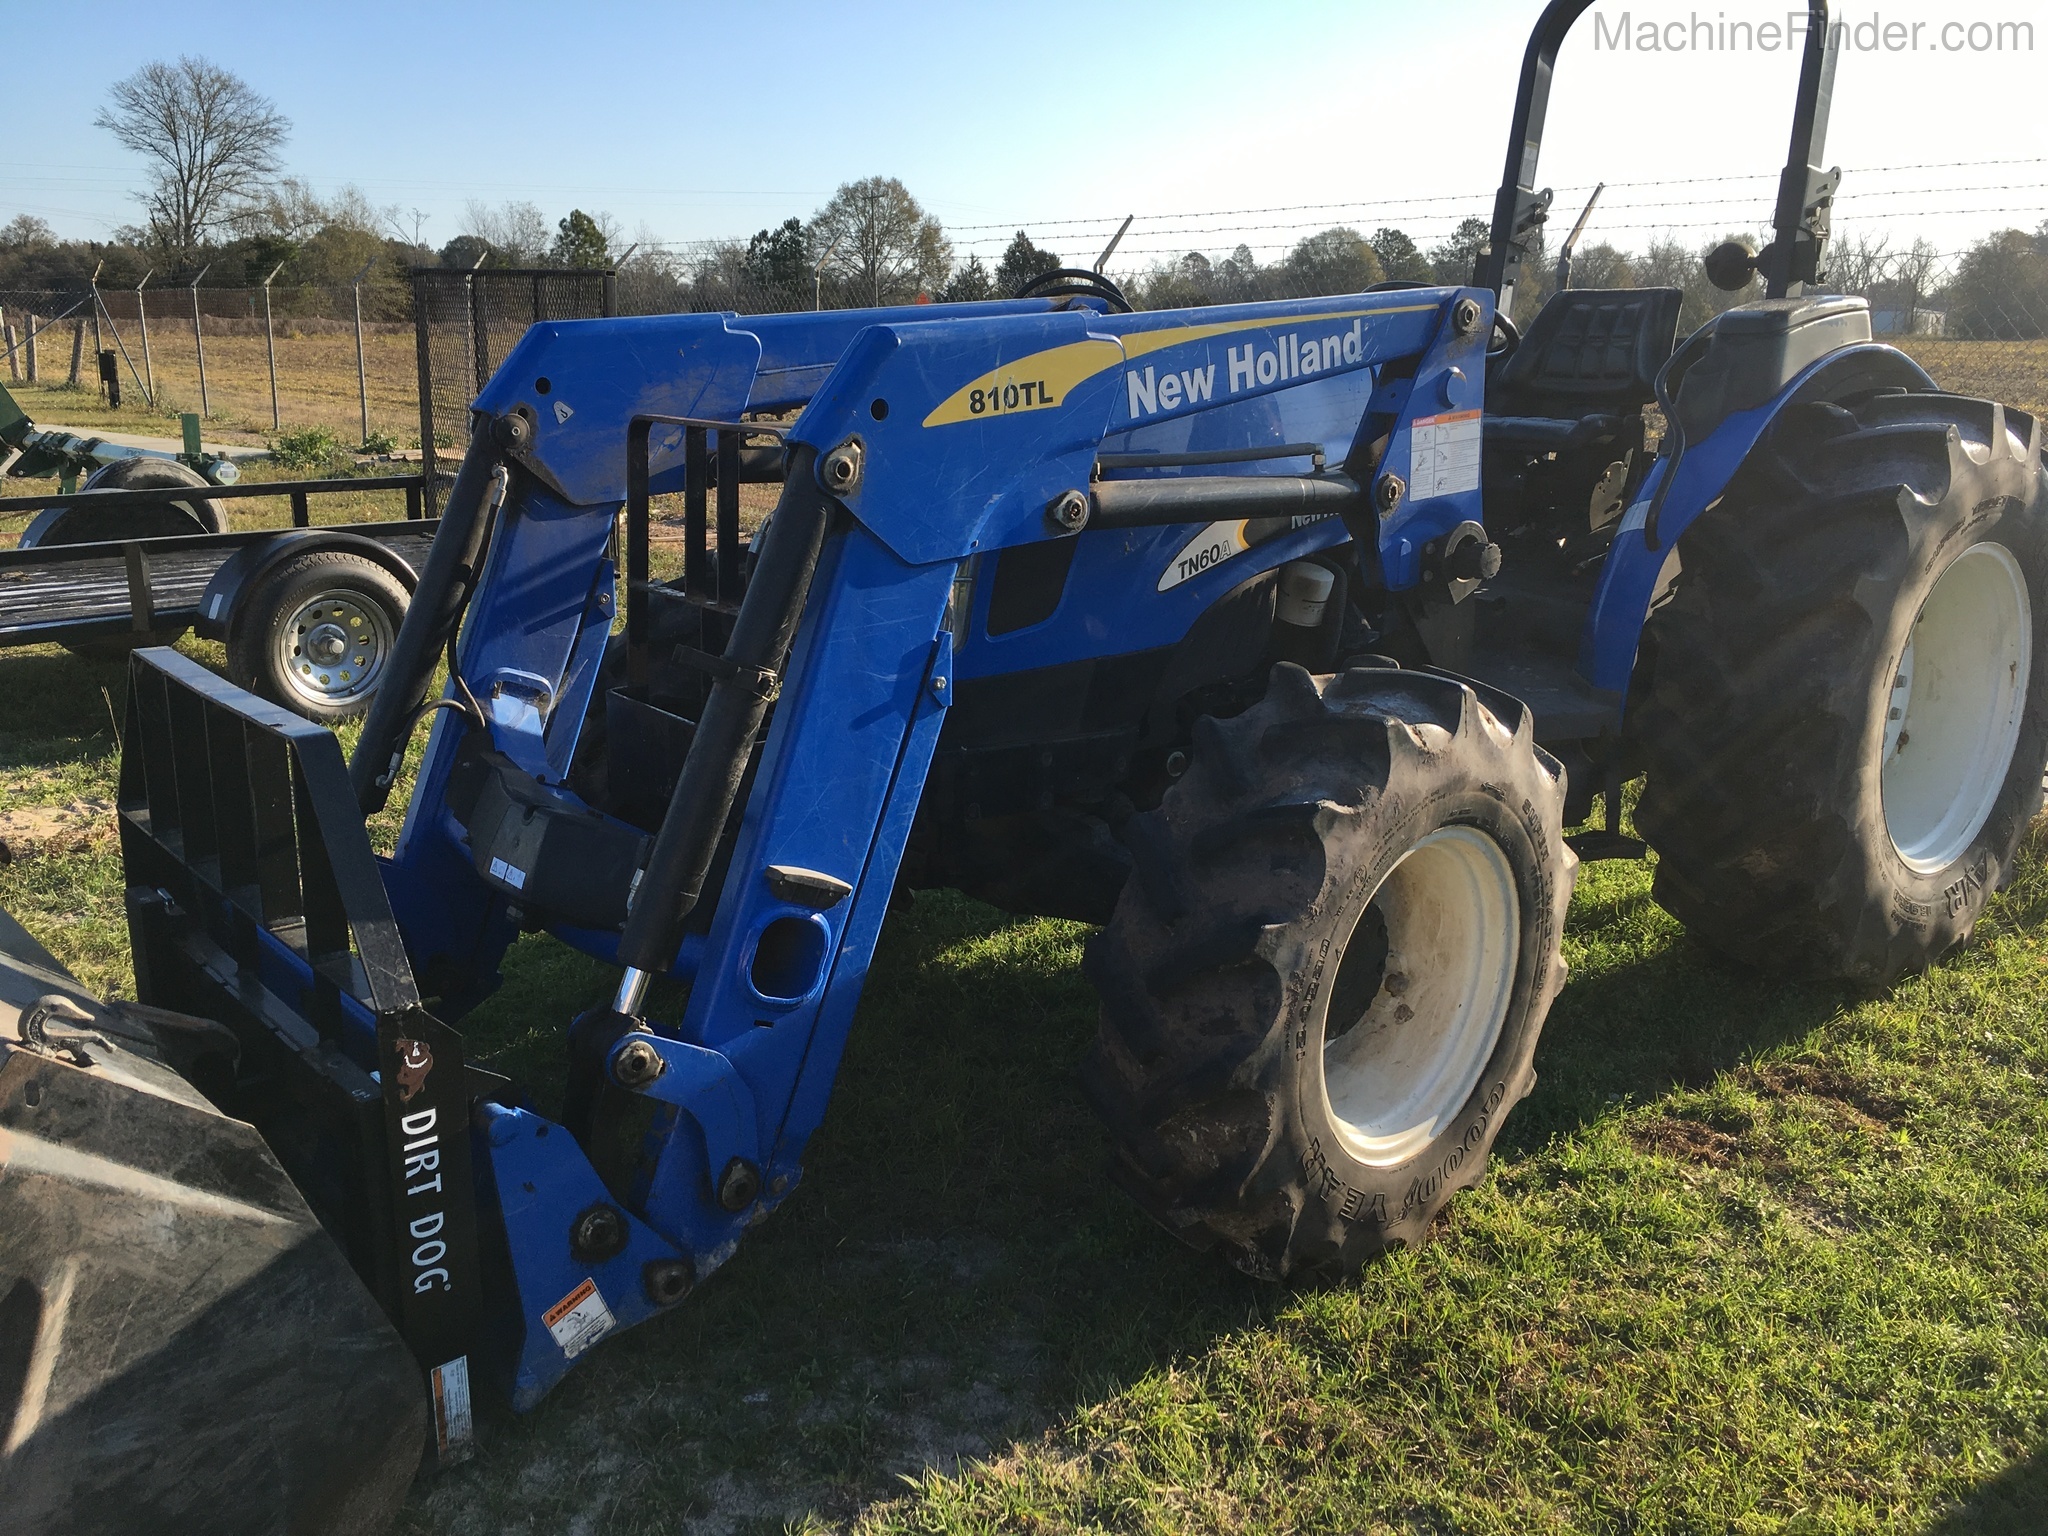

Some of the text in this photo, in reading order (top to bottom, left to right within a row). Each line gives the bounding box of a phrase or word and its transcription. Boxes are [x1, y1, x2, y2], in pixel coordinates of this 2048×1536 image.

[1125, 319, 1362, 420] New Holland
[968, 380, 1054, 415] 810TL
[1178, 540, 1231, 580] TN60A
[401, 1108, 442, 1196] DIRT
[555, 1285, 592, 1316] WARNING
